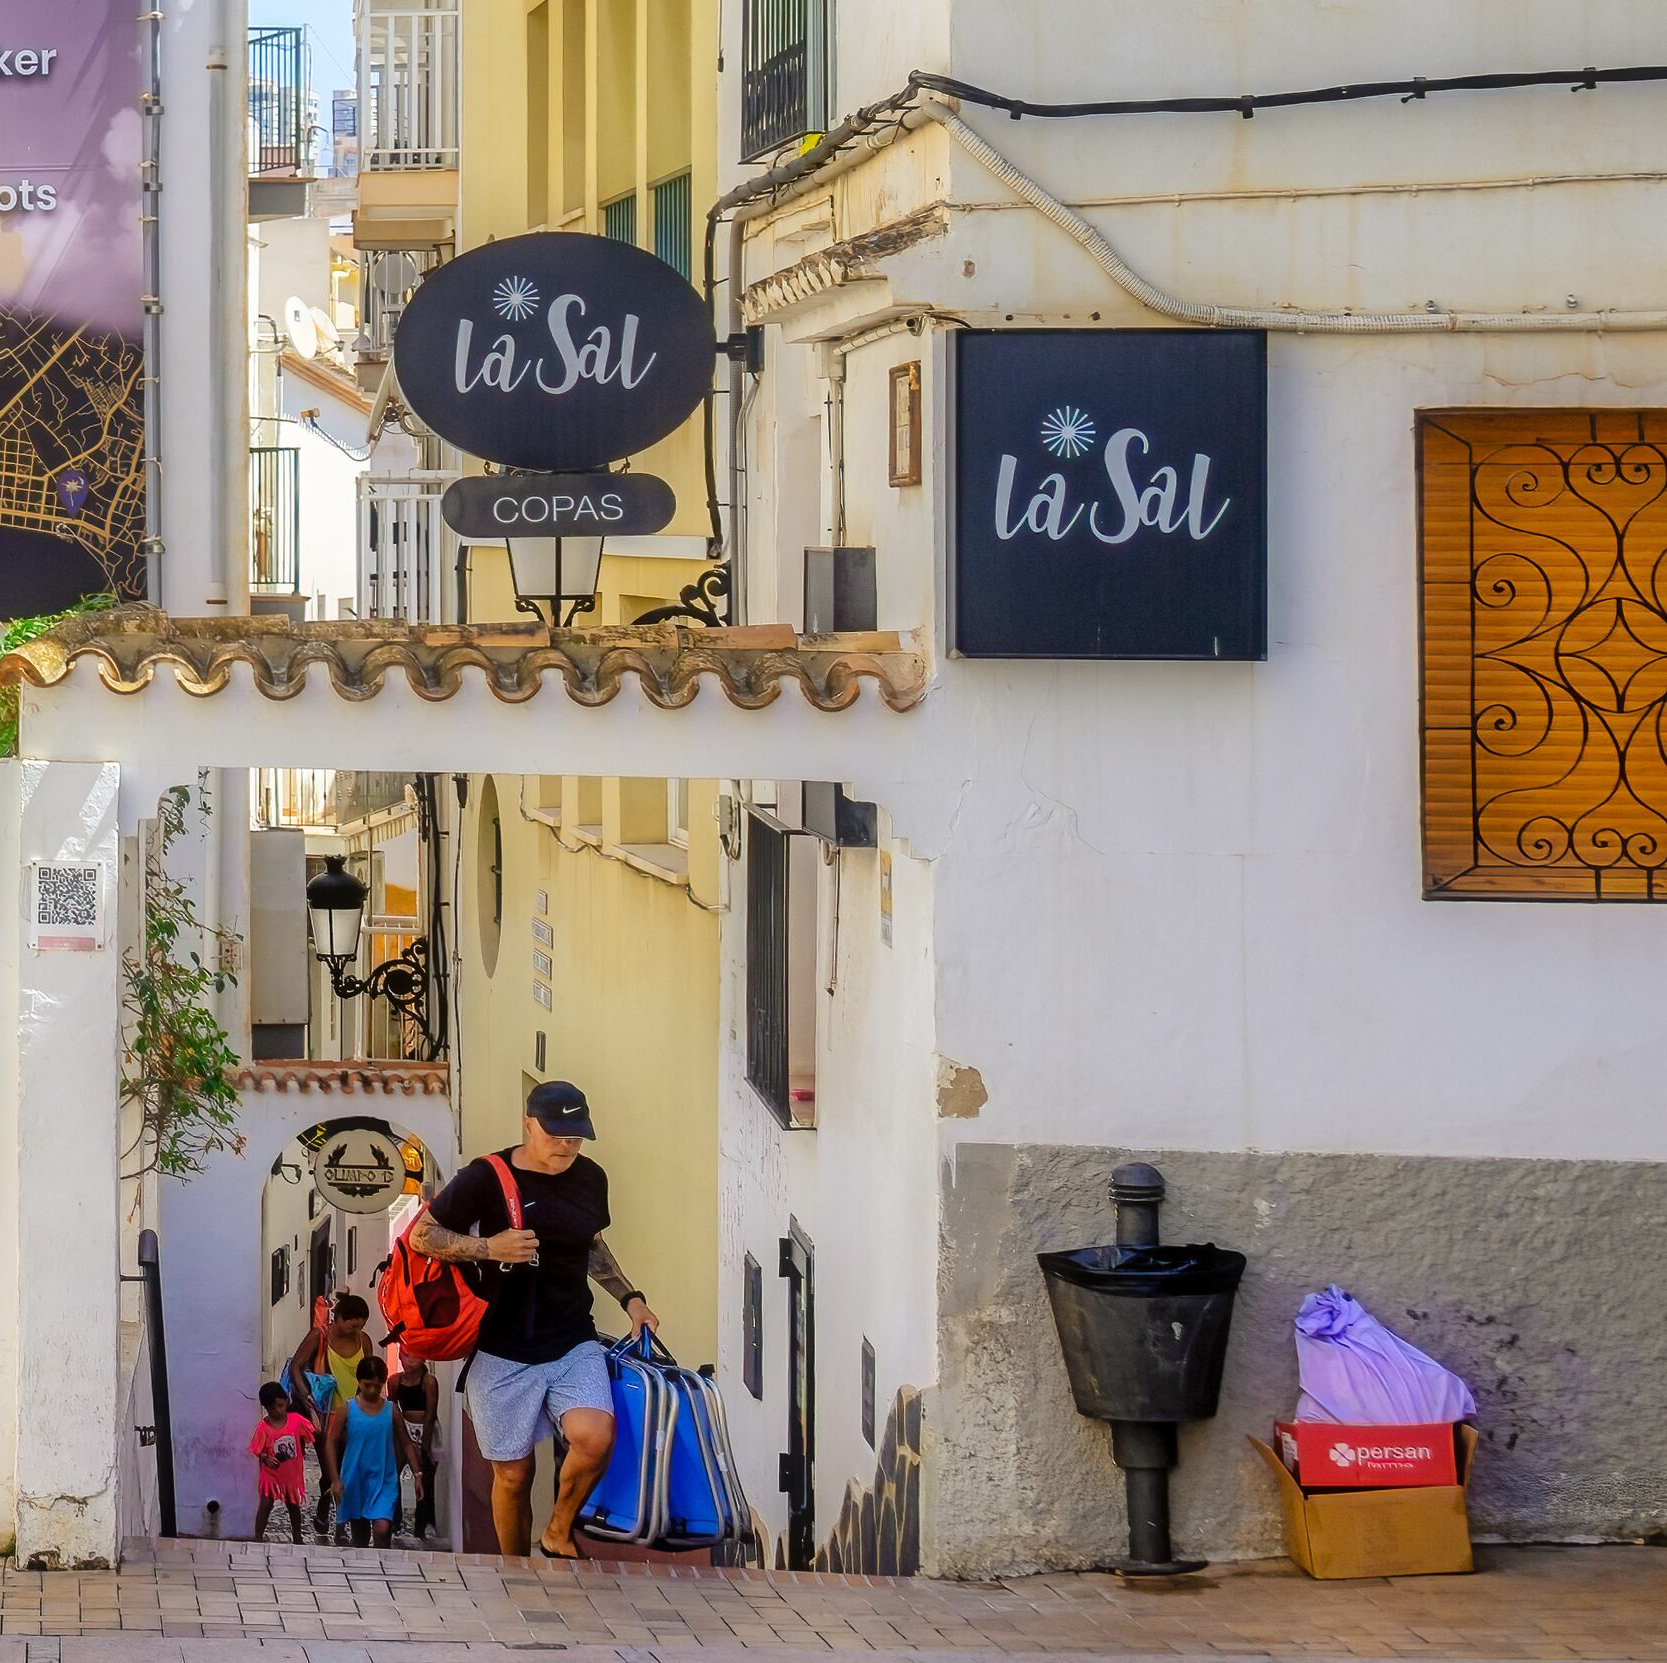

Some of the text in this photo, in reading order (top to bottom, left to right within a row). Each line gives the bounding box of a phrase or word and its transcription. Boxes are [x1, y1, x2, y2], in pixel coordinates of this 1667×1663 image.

[536, 293, 657, 395] Sal
[493, 494, 624, 524] COPAS
[1090, 428, 1231, 544] Sal
[1356, 1446, 1431, 1465] persan
